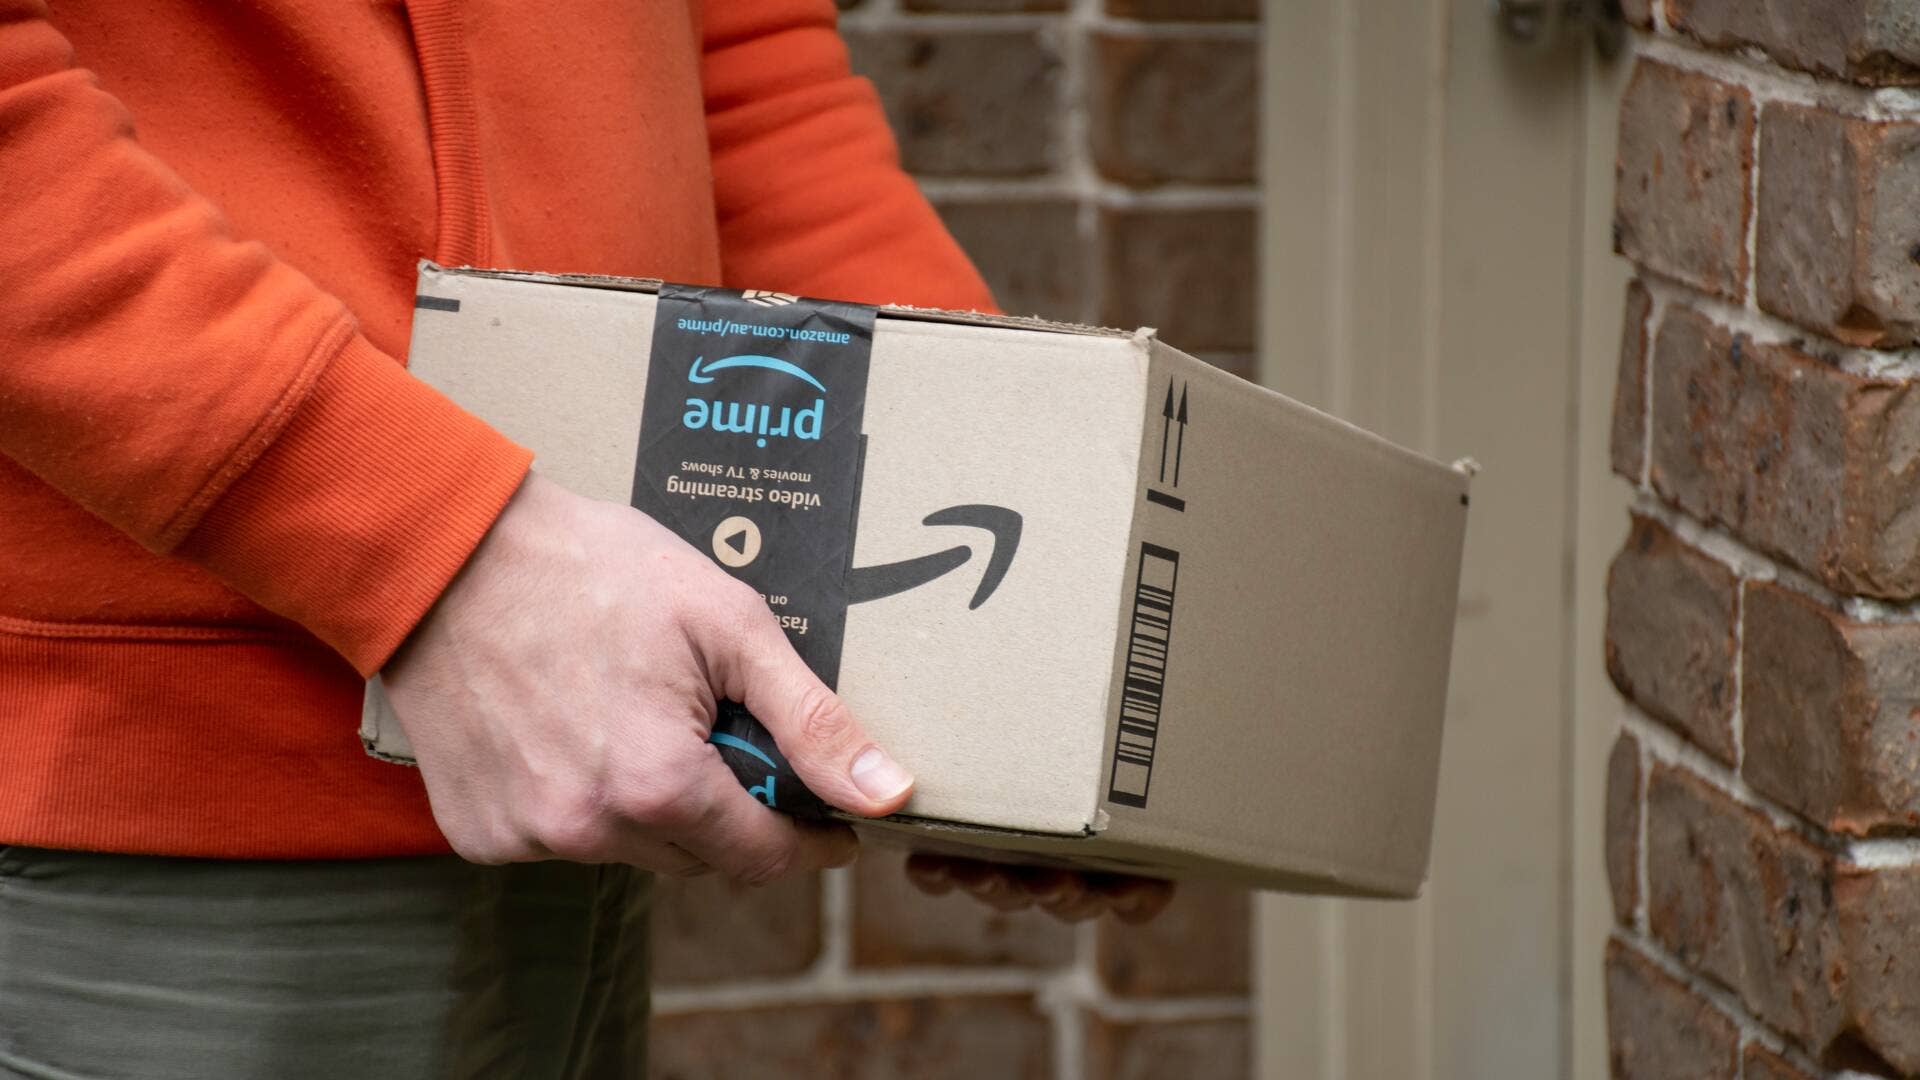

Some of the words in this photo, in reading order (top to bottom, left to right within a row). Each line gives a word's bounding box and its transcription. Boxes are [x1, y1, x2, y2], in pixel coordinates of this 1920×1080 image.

[677, 318, 850, 344] amazon.com.au/prime
[683, 398, 825, 448] prime
[681, 461, 723, 475] shows
[726, 463, 745, 479] TV
[750, 468, 760, 480] &
[764, 469, 811, 483] movies
[666, 475, 764, 503] streaming
[769, 489, 821, 510] video
[770, 595, 788, 605] on
